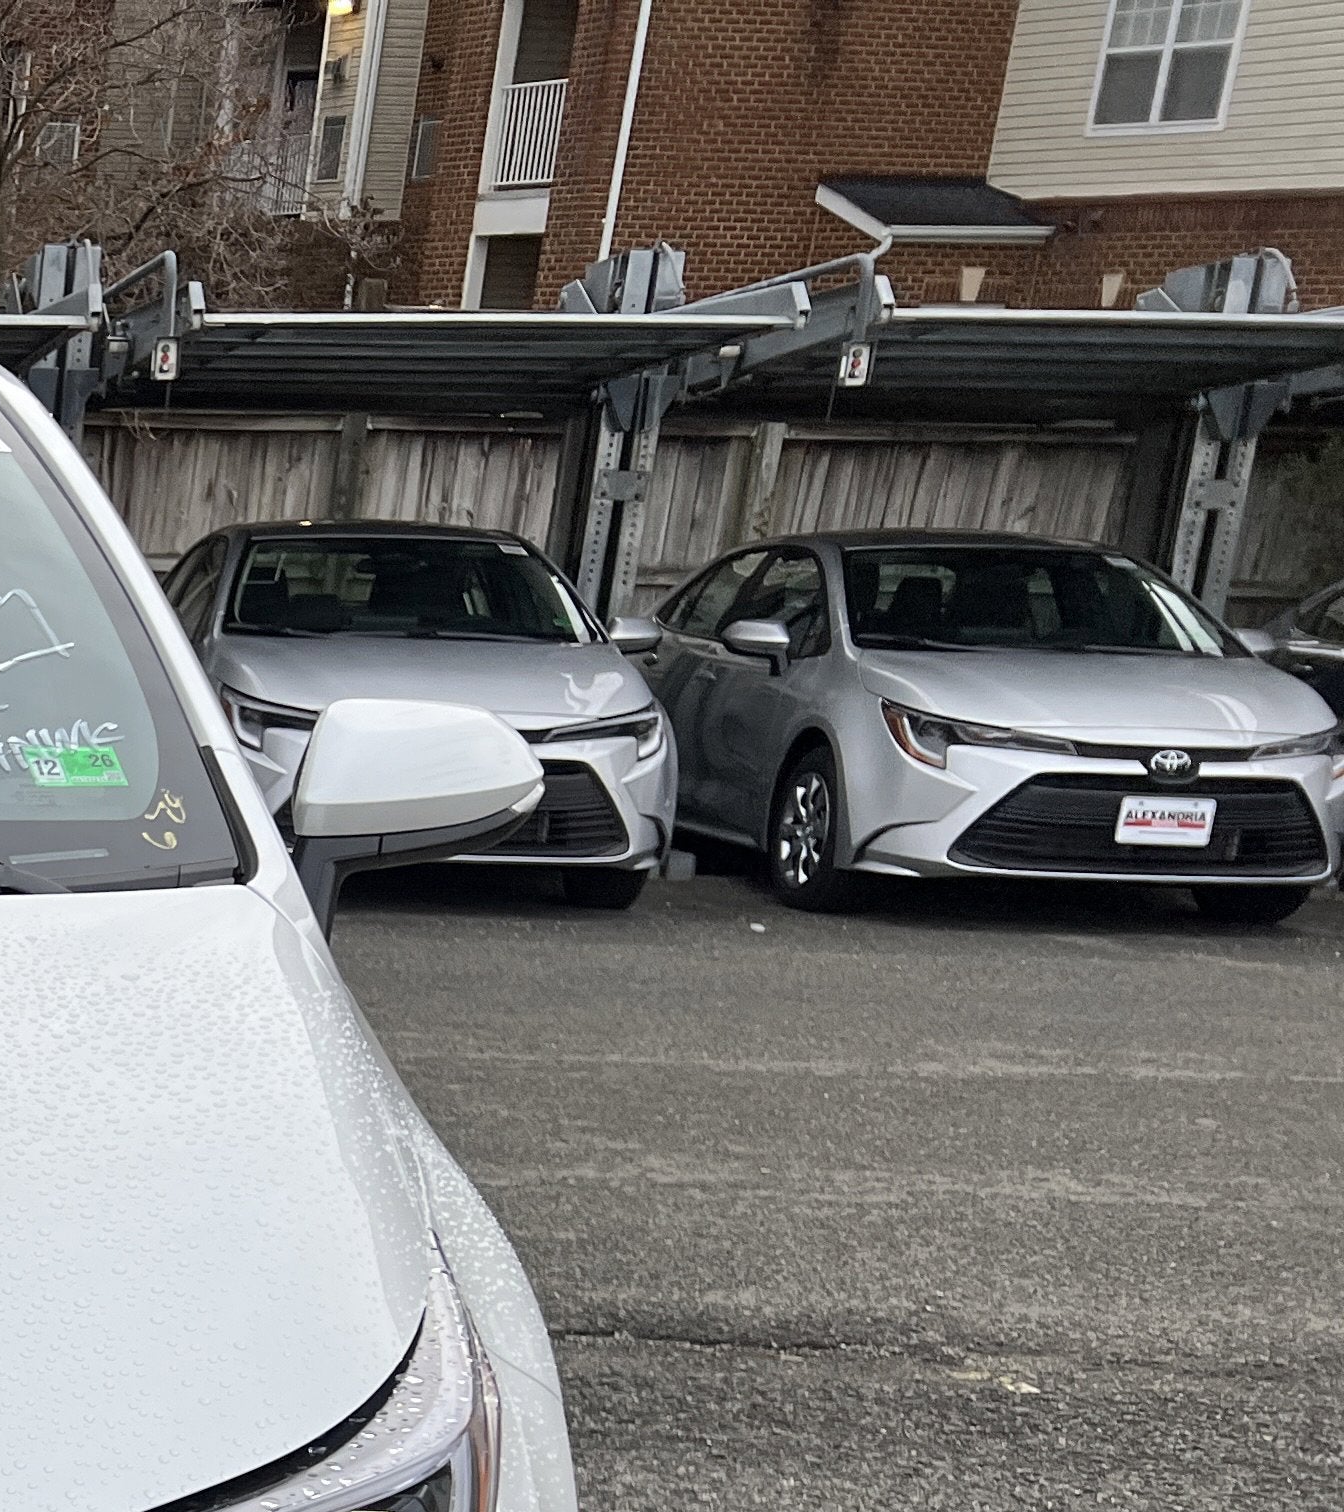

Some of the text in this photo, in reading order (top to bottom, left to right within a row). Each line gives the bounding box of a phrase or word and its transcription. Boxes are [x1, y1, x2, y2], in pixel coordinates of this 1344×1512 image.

[34, 754, 114, 777] 12 26
[1125, 810, 1207, 822] ALEXANDRIA
